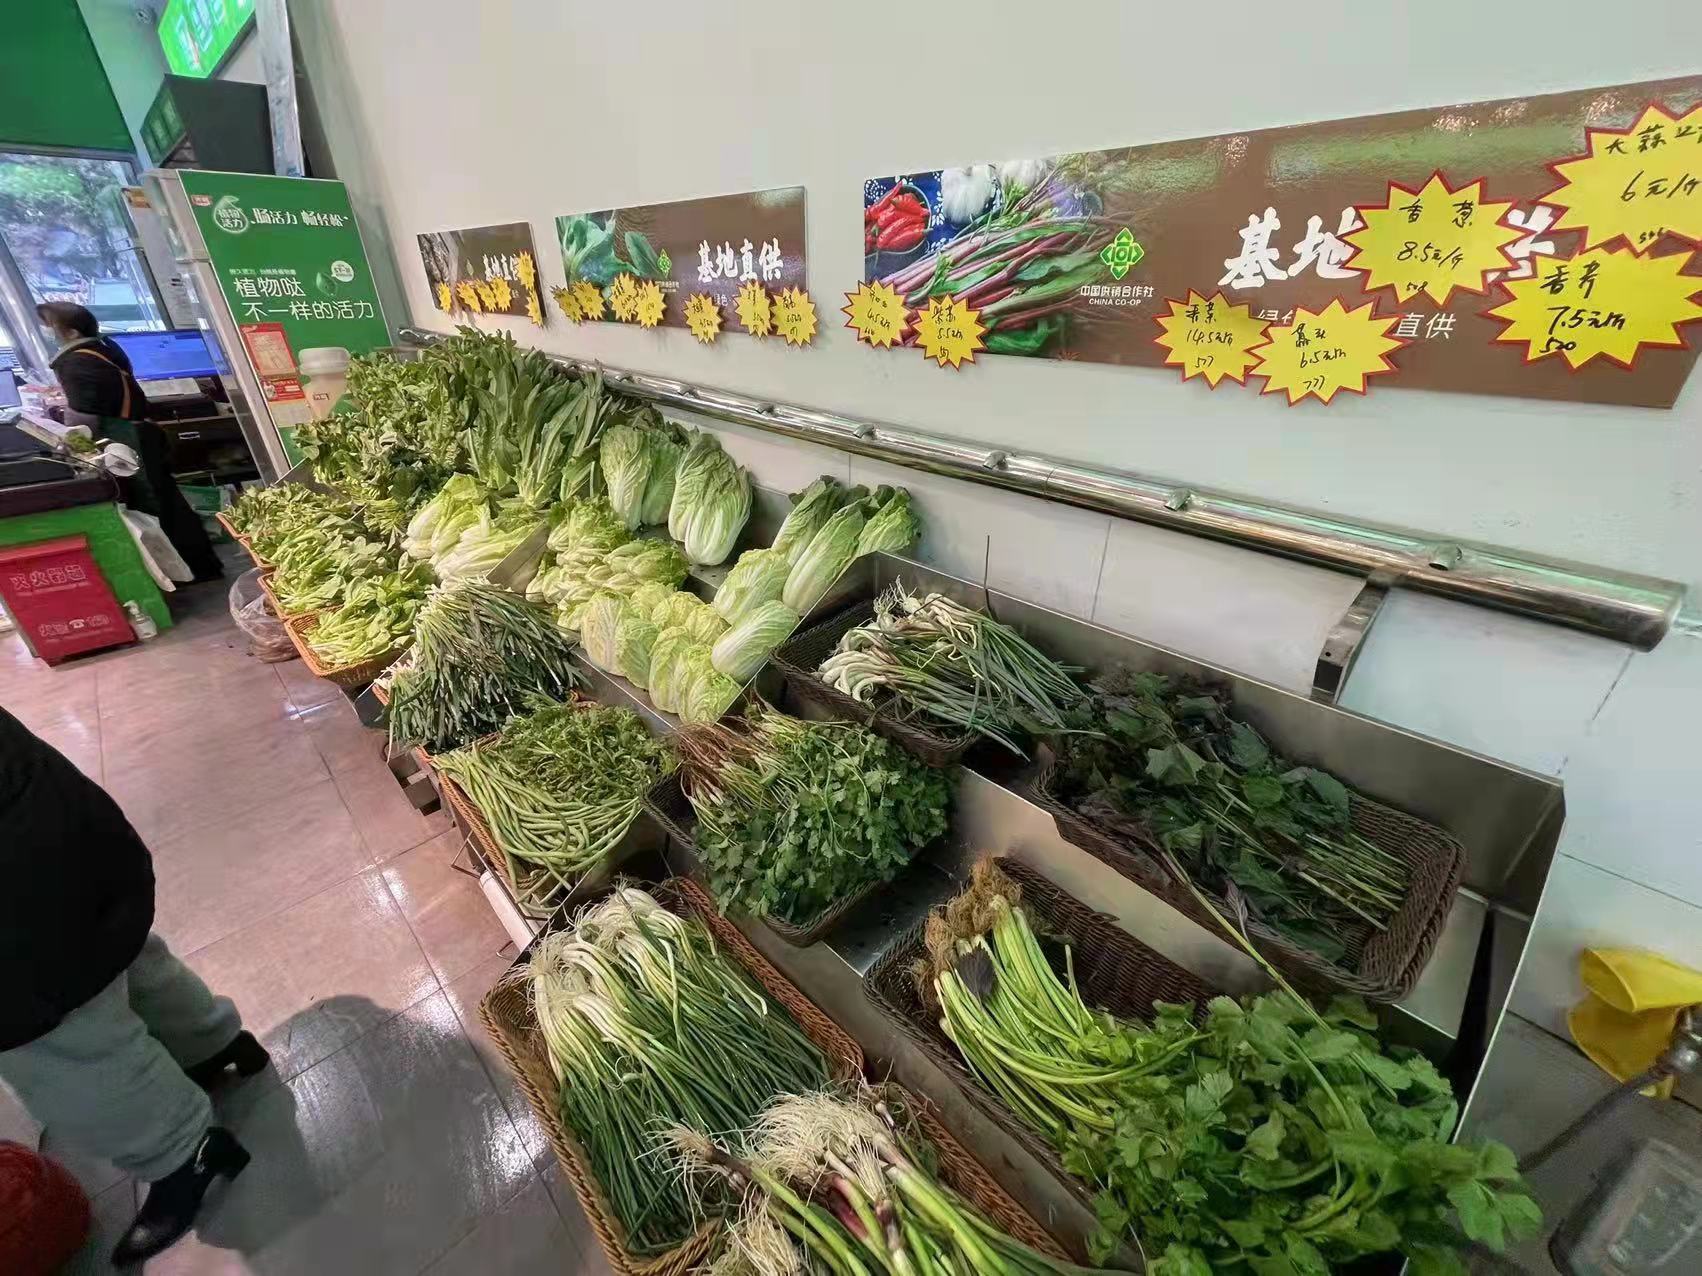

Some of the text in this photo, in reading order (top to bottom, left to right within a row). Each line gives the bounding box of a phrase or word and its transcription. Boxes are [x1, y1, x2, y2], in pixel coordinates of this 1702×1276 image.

[1398, 198, 1475, 229] 香葱
[697, 238, 784, 283] 基地直供
[1396, 241, 1465, 271] 8.5元/斤
[234, 277, 306, 298] 植物哒
[1080, 285, 1155, 298] 中国供销合作社
[241, 300, 374, 321] 不一样的活力
[1088, 298, 1142, 306] CHINA CO-OP
